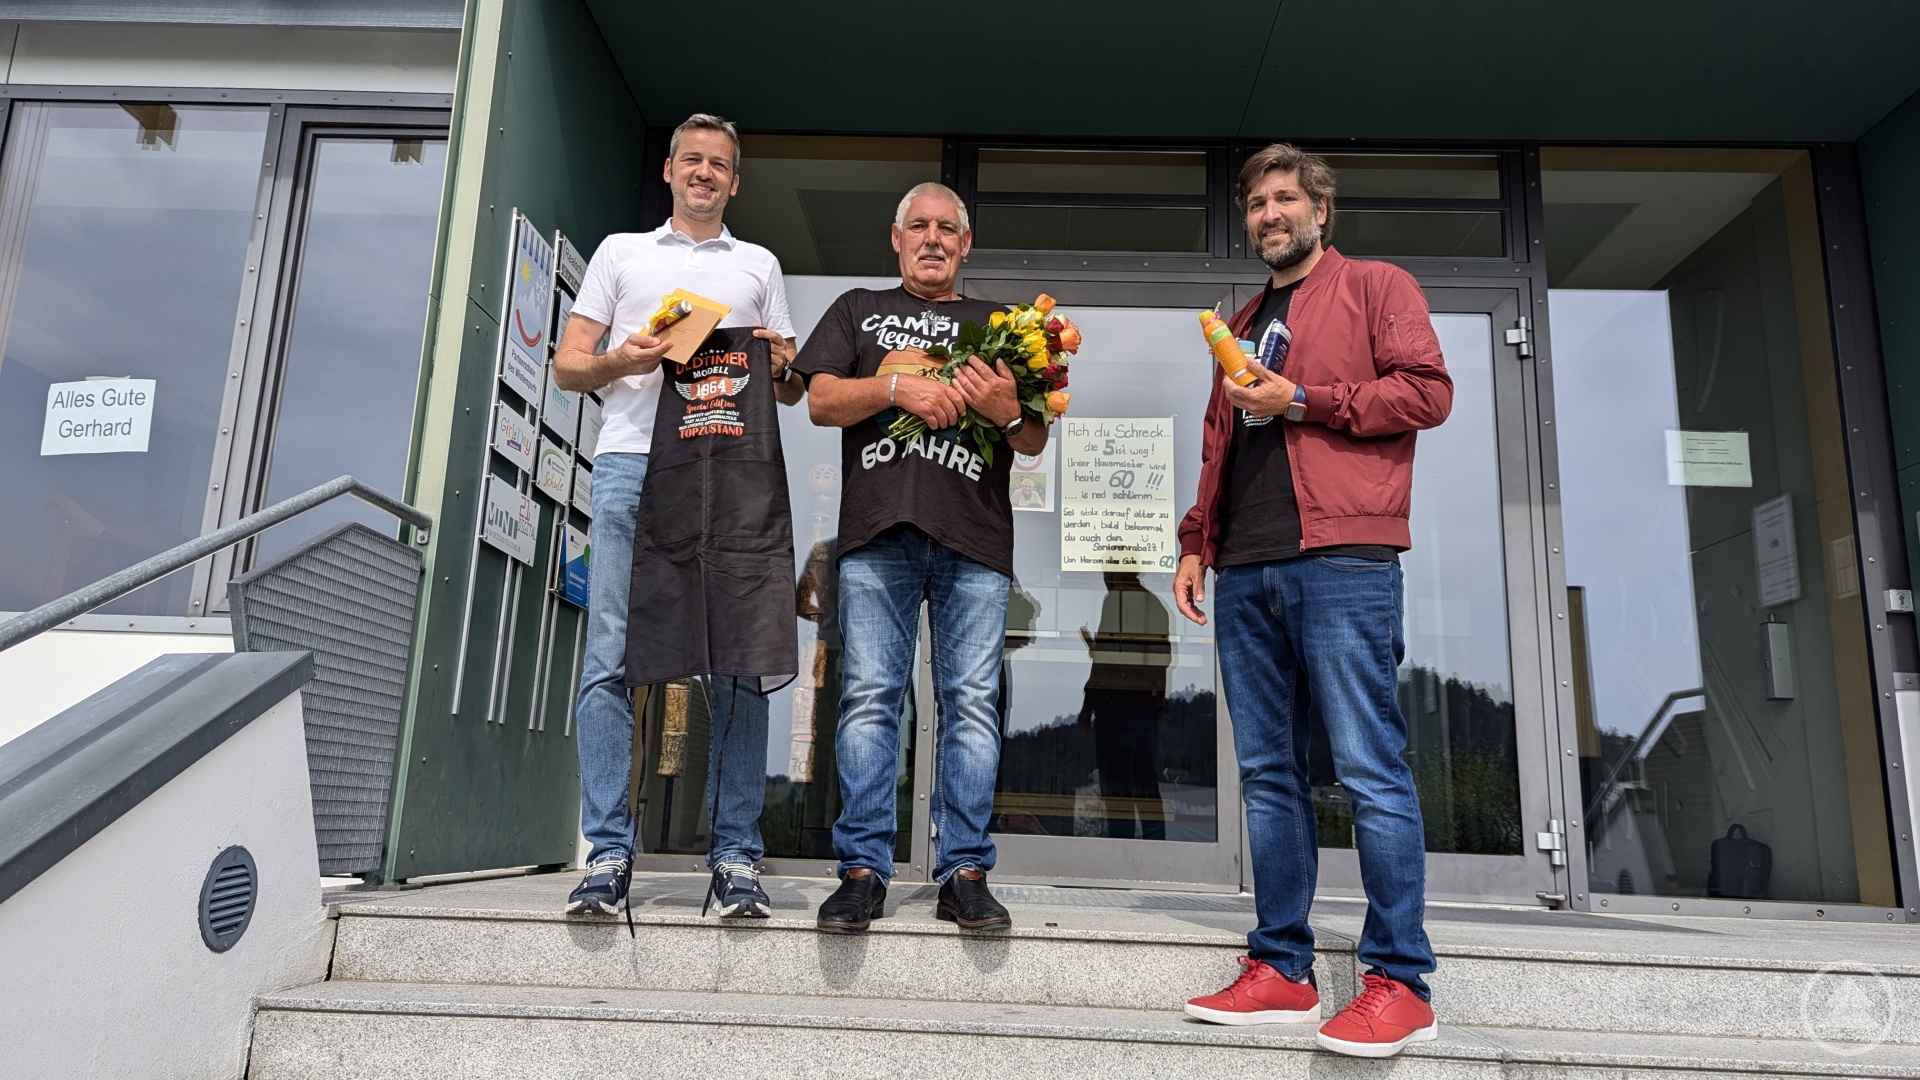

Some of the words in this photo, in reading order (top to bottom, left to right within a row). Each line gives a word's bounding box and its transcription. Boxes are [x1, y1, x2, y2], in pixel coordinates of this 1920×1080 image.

[861, 313, 960, 337] CAMPI
[511, 348, 536, 378] Partnerschule
[507, 361, 515, 374] des
[515, 366, 537, 394] Wintersports
[692, 366, 729, 379] MODELL
[695, 379, 727, 397] 1964
[52, 390, 96, 409] Alles
[101, 388, 146, 407] Gute
[686, 401, 709, 414] Special
[709, 398, 737, 409] Edition
[58, 417, 133, 438] Gerhard
[680, 424, 744, 439] TOPZUSTAND
[1068, 422, 1090, 437] Ach
[1094, 422, 1110, 437] du
[1084, 441, 1098, 452] die
[1102, 439, 1116, 456] 5
[1115, 444, 1127, 455] ist
[861, 437, 896, 470] 60
[901, 432, 985, 482] JAHRE
[1067, 457, 1090, 468] Unser
[1094, 457, 1145, 469] Hausmeister
[1149, 462, 1167, 471] wird
[543, 471, 565, 492] Schule
[1074, 470, 1102, 482] heute
[1108, 469, 1136, 489] 60
[1145, 472, 1165, 490] !!!
[1081, 491, 1089, 499] is
[1091, 490, 1107, 499] ned
[1112, 490, 1153, 500] schlimm
[487, 501, 519, 540] MINT
[1062, 507, 1075, 517] Sei
[1080, 507, 1099, 517] stolz
[1101, 507, 1132, 520] darauf
[1133, 508, 1156, 519] älter
[1158, 511, 1169, 519] zu
[1100, 520, 1120, 530] bald
[1124, 521, 1164, 533] bekommst
[1064, 532, 1076, 542] du
[1079, 533, 1101, 542] auch
[1080, 555, 1104, 565] Herzen
[1105, 556, 1120, 565] alles
[1122, 556, 1138, 565] Gute
